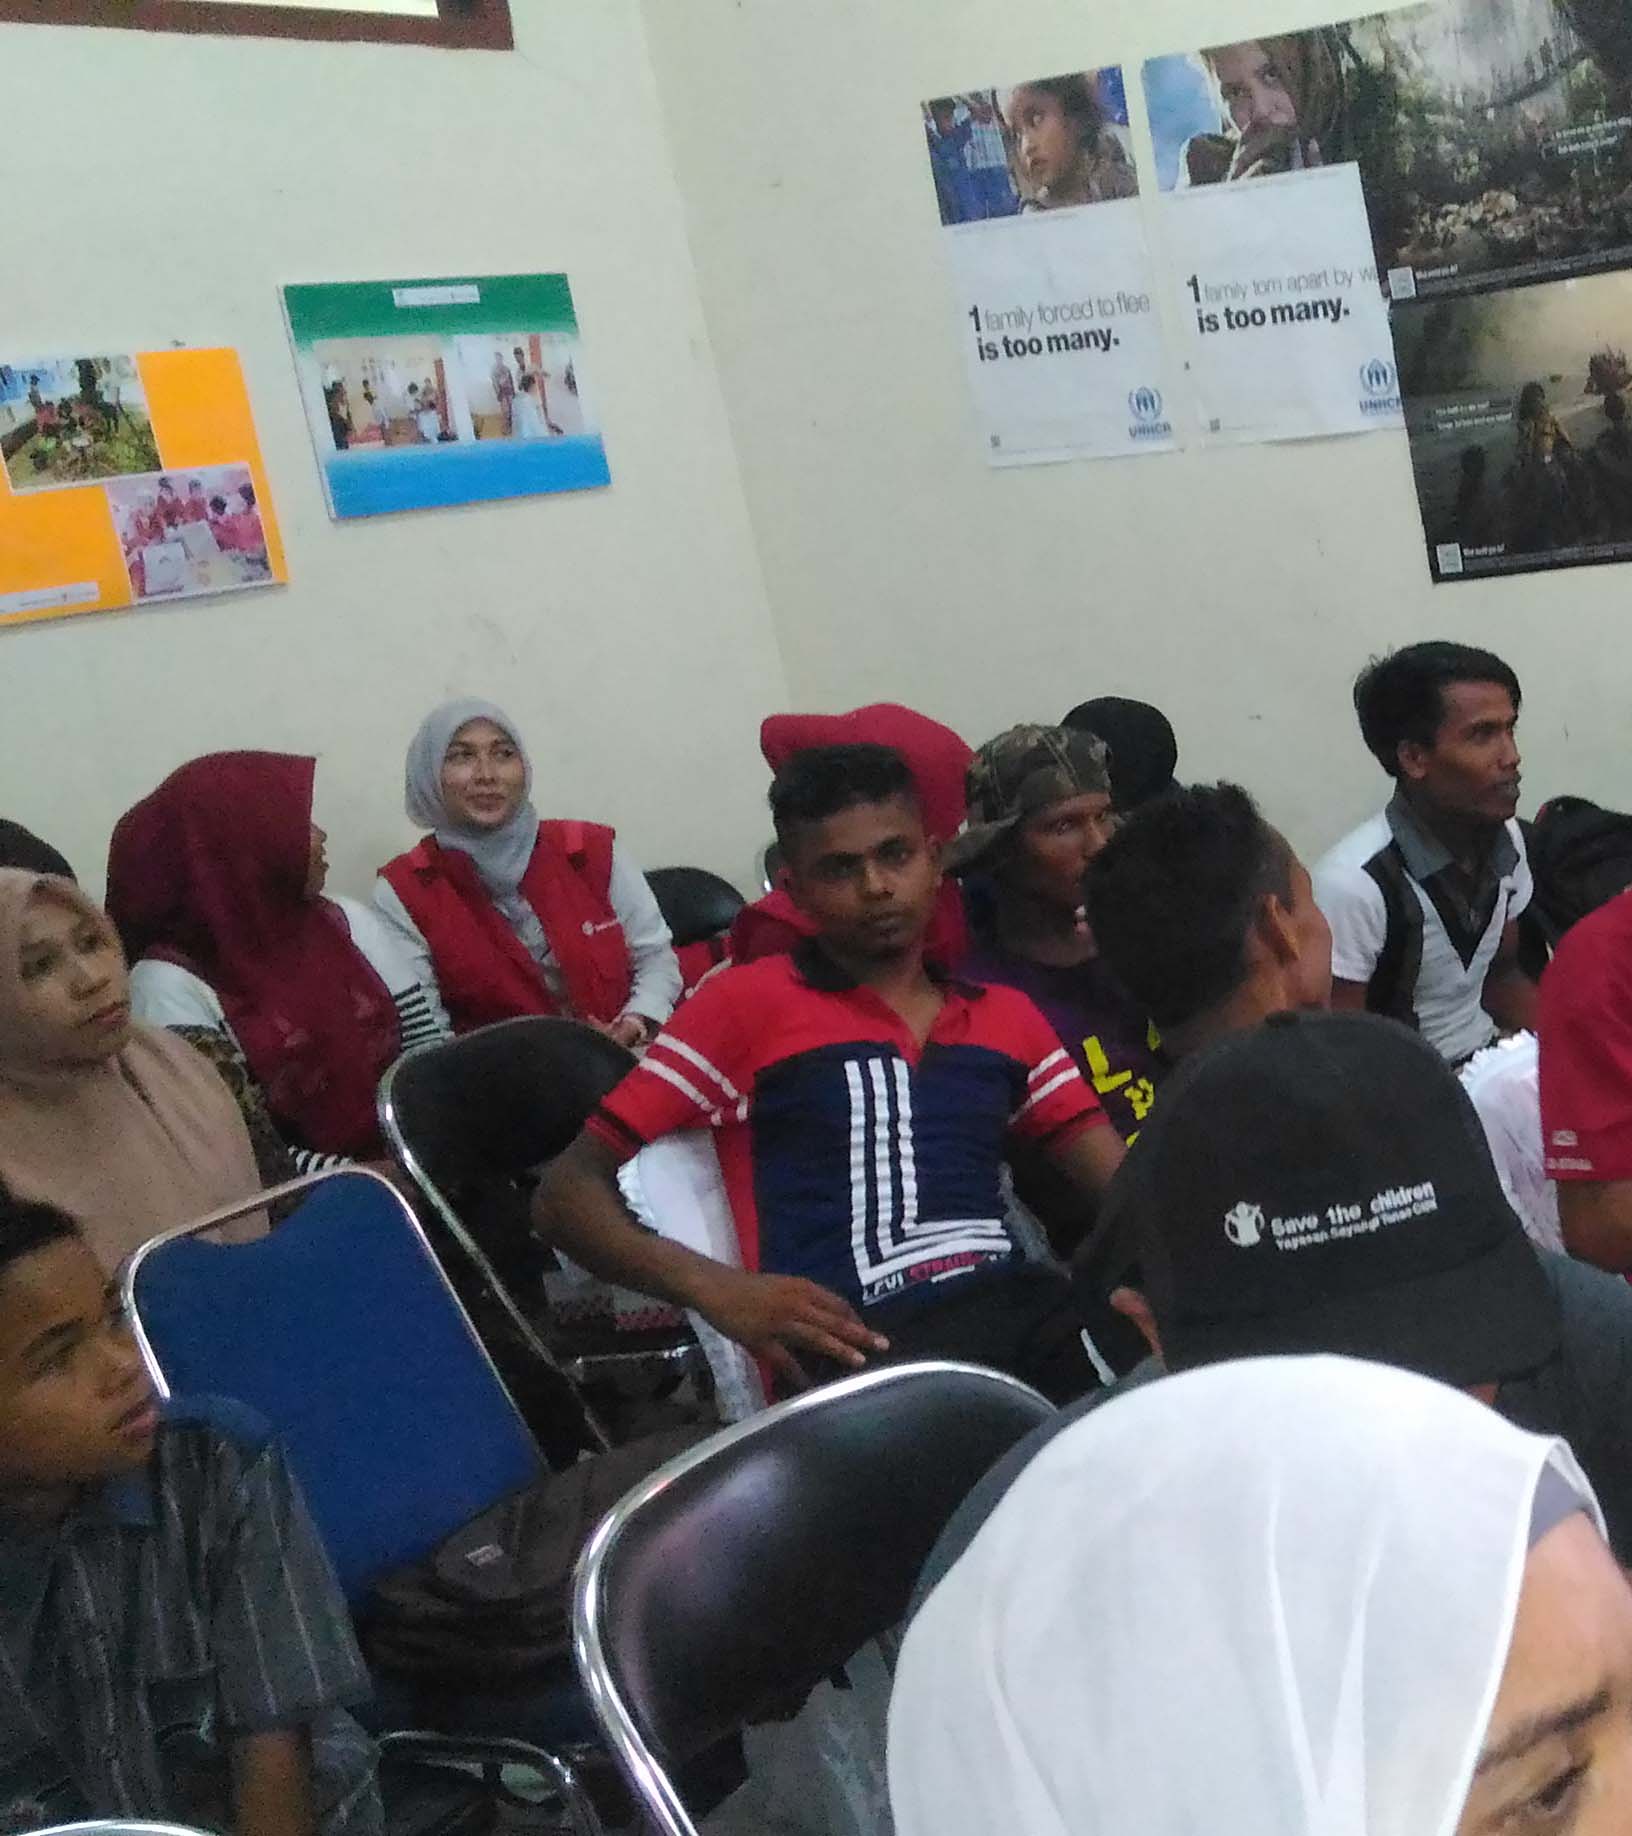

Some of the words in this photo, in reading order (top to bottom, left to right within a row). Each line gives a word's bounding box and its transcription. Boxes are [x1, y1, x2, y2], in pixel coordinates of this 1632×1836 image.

[1186, 274, 1200, 303] 1
[1203, 281, 1247, 305] family
[1287, 269, 1328, 291] apart
[1334, 268, 1353, 289] by
[968, 304, 981, 332] 1
[984, 305, 1033, 335] family
[1037, 297, 1094, 326] forced
[1097, 296, 1116, 317] to
[1117, 291, 1150, 314] flee
[1197, 307, 1219, 334] is
[1224, 307, 1266, 331] too
[1270, 297, 1350, 324] many.
[977, 337, 999, 362] is
[1002, 335, 1043, 358] too
[1047, 328, 1120, 353] many.
[1271, 1213, 1319, 1238] Save
[1325, 1203, 1362, 1226] the
[1369, 1180, 1437, 1216] children
[1275, 1229, 1329, 1251] Yayasan
